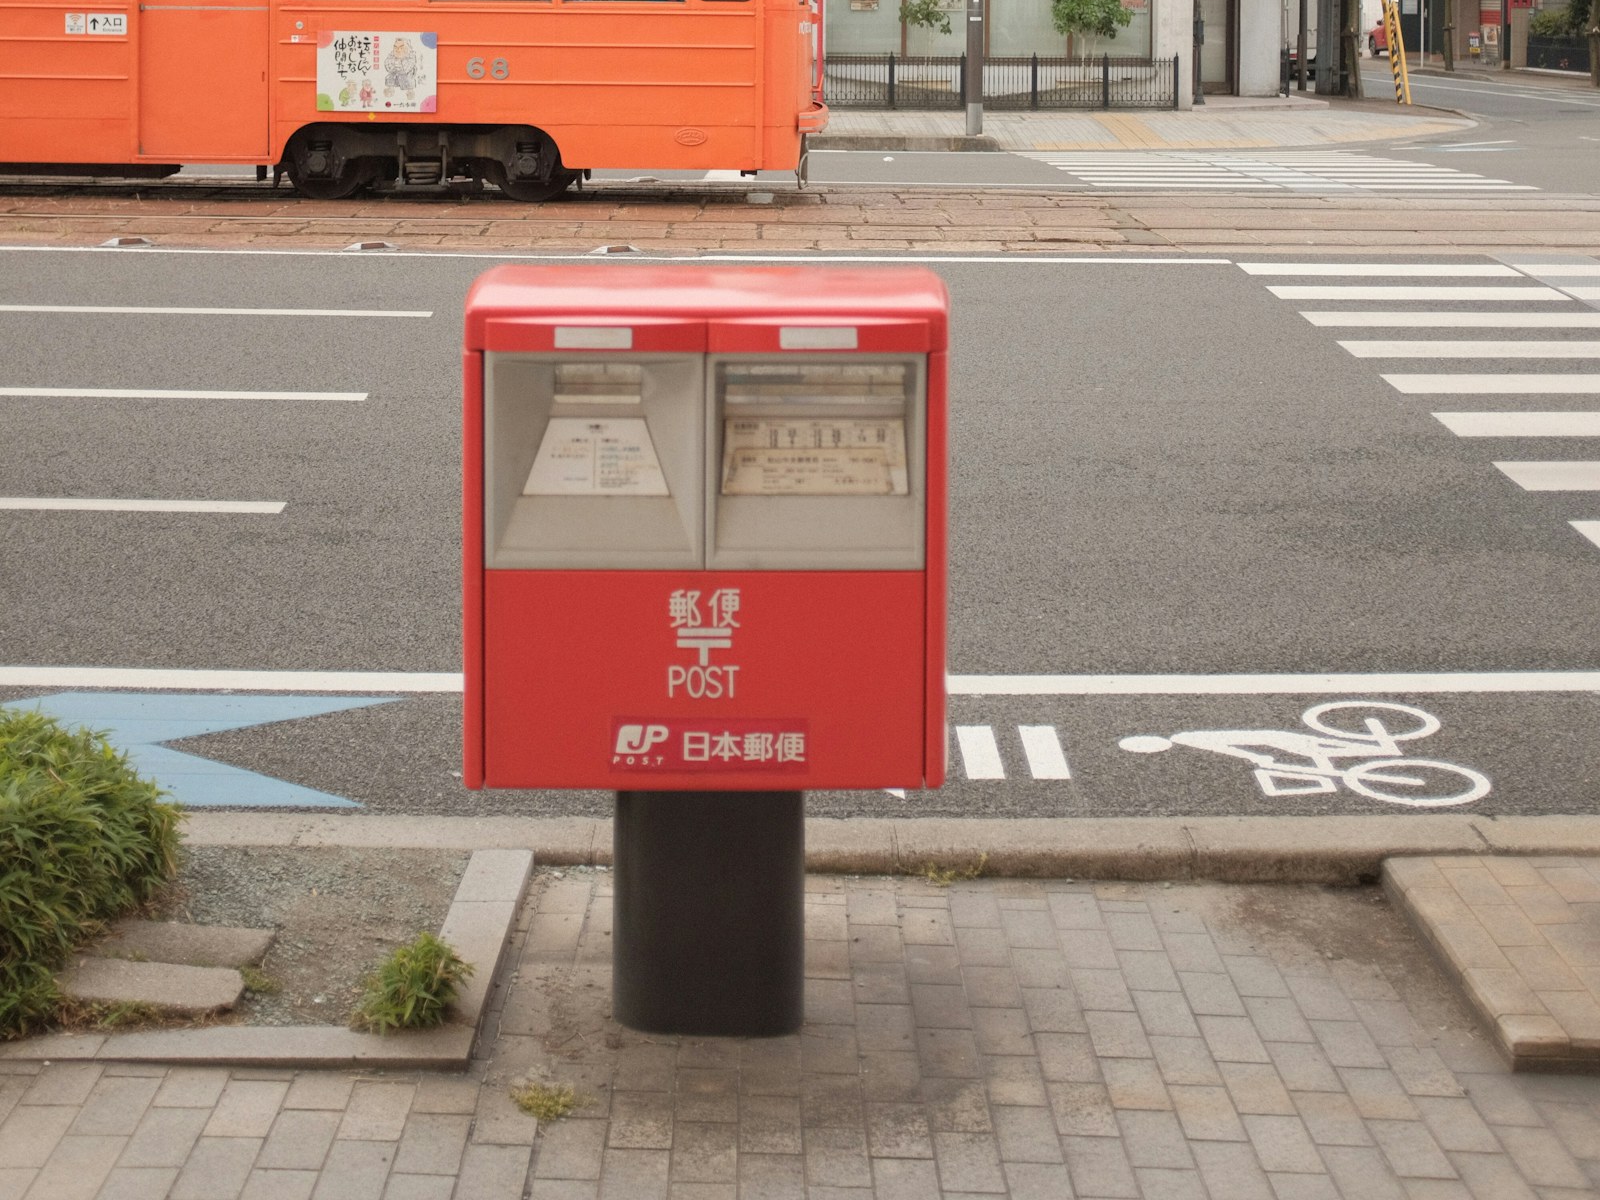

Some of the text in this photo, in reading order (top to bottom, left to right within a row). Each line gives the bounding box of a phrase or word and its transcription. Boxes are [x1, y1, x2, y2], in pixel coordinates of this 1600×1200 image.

[103, 17, 122, 26] 入口
[466, 57, 509, 80] 68
[669, 588, 741, 628] 郵便
[668, 665, 740, 699] POST
[615, 724, 669, 754] JP
[682, 731, 806, 762] 日本郵便
[612, 755, 664, 766] POST
